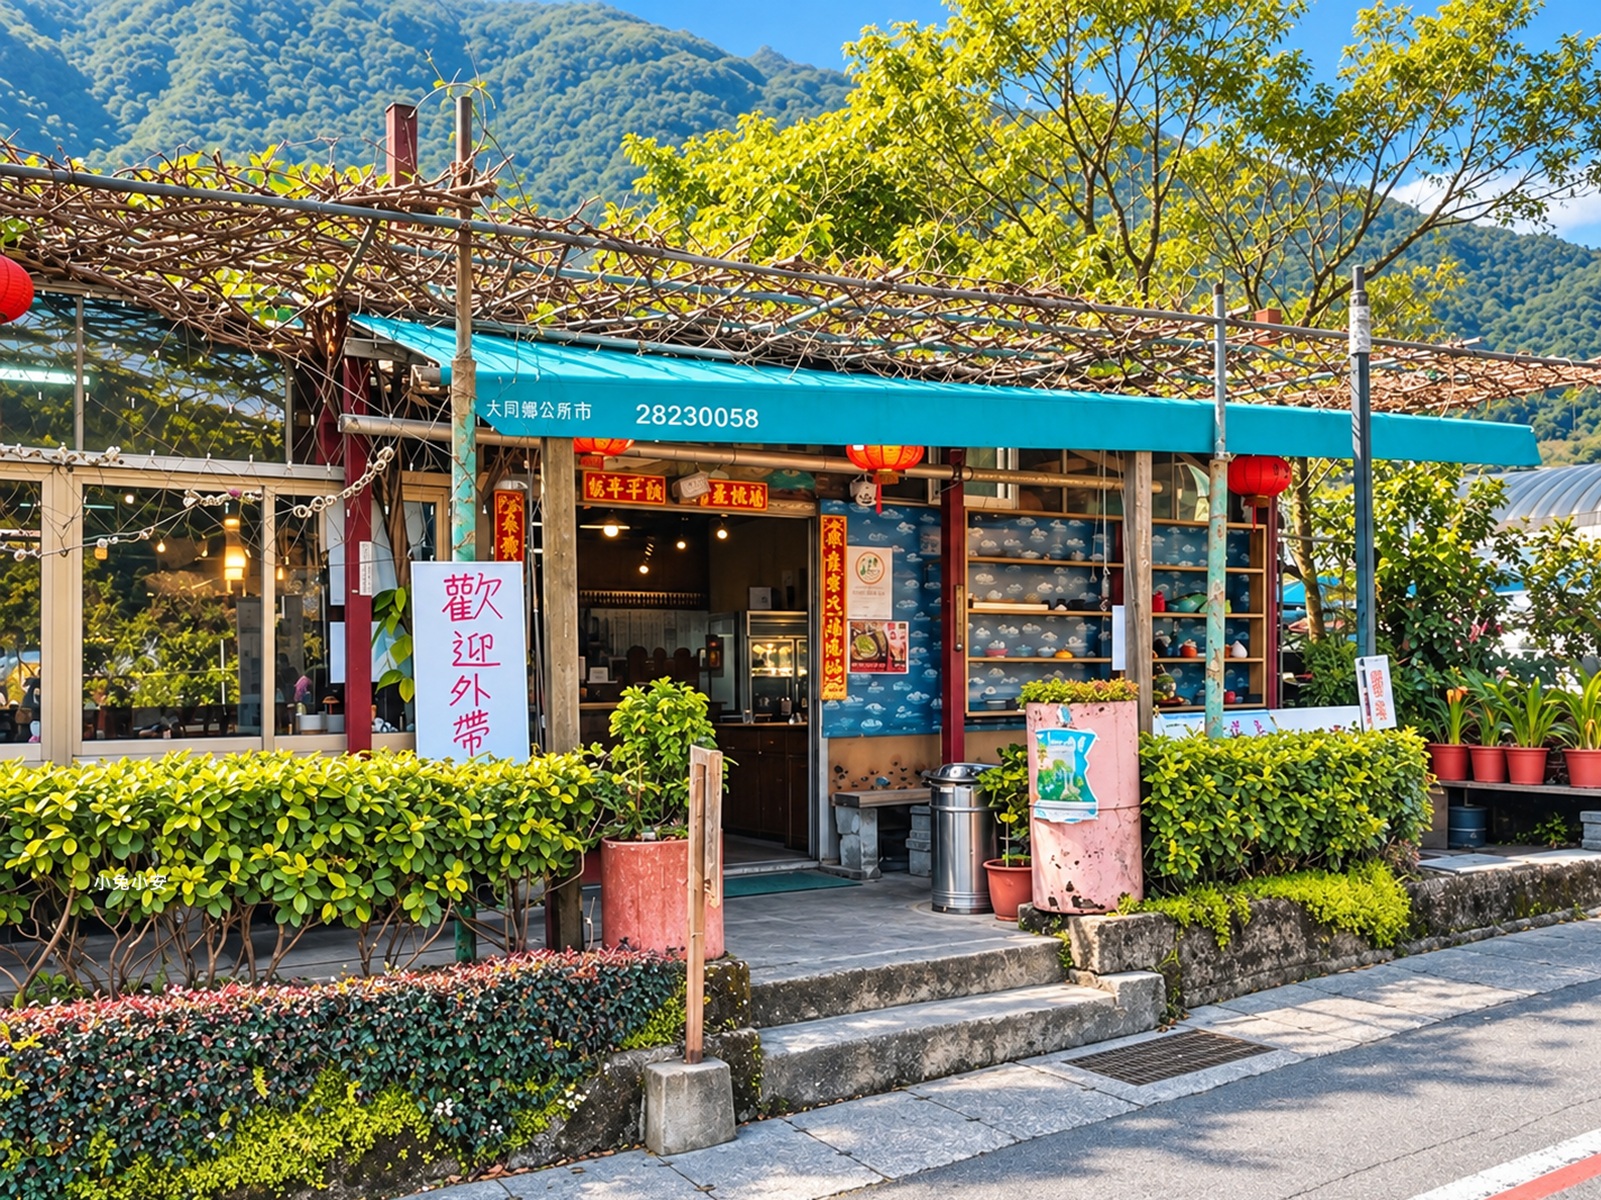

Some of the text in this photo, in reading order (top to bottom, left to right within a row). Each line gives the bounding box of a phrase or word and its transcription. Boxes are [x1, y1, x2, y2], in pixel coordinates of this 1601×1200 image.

[635, 403, 760, 429] 28230058
[441, 572, 504, 757] 歡迎外帶
